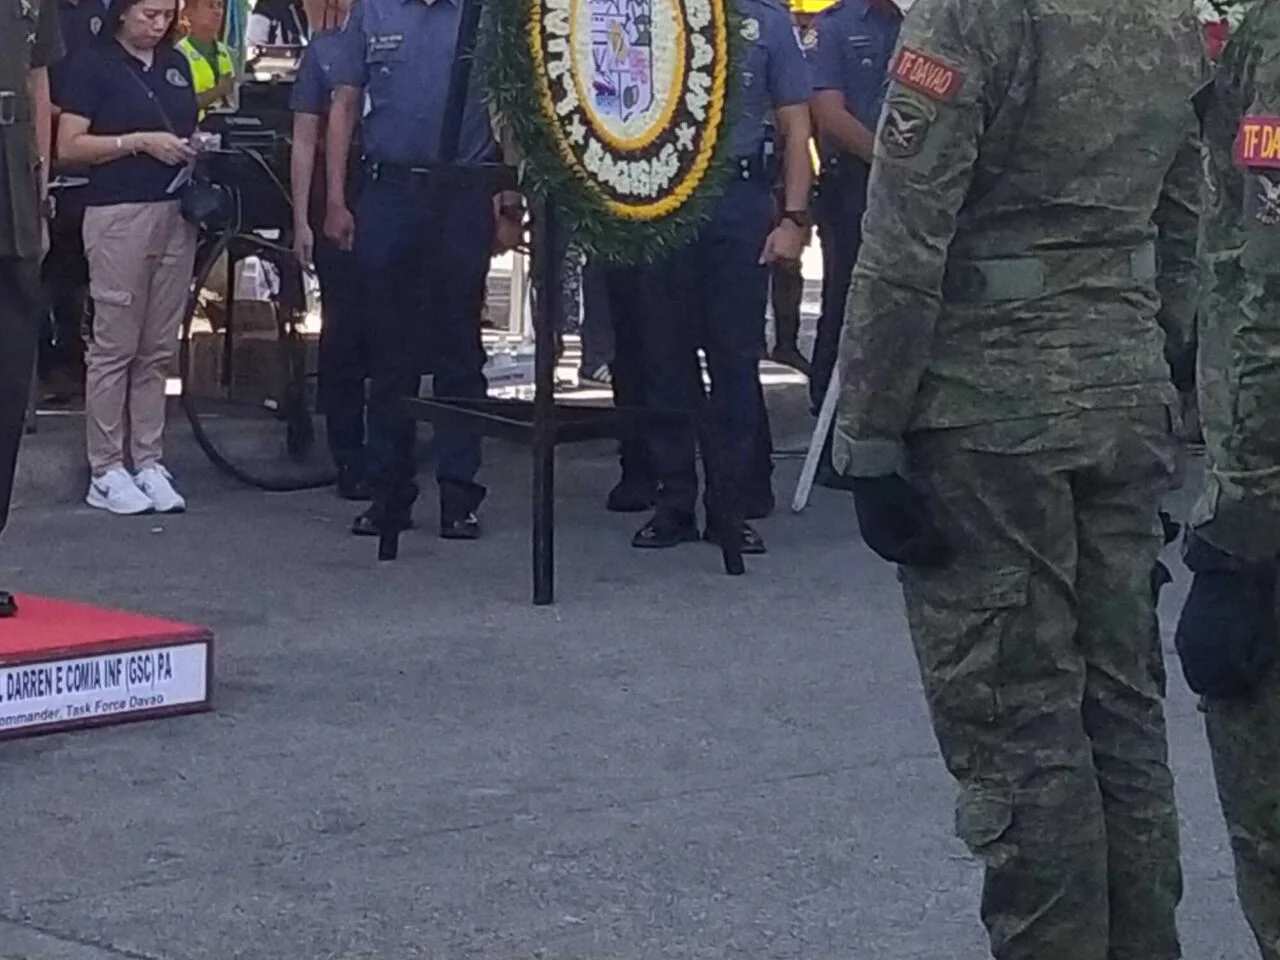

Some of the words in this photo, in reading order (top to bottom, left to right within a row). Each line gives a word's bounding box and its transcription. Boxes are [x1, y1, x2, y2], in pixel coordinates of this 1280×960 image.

[896, 51, 916, 76] TF
[910, 57, 953, 94] DAVAO
[1243, 125, 1261, 158] TF
[1260, 125, 1280, 159] DA
[6, 665, 53, 701] DARREN
[55, 665, 63, 694] E
[66, 660, 102, 692] COMIA
[104, 658, 122, 689] INF
[125, 654, 156, 692] (GSC)
[157, 651, 173, 680] PA
[66, 704, 91, 717] Task
[94, 699, 126, 714] Force
[129, 694, 164, 708] Davao
